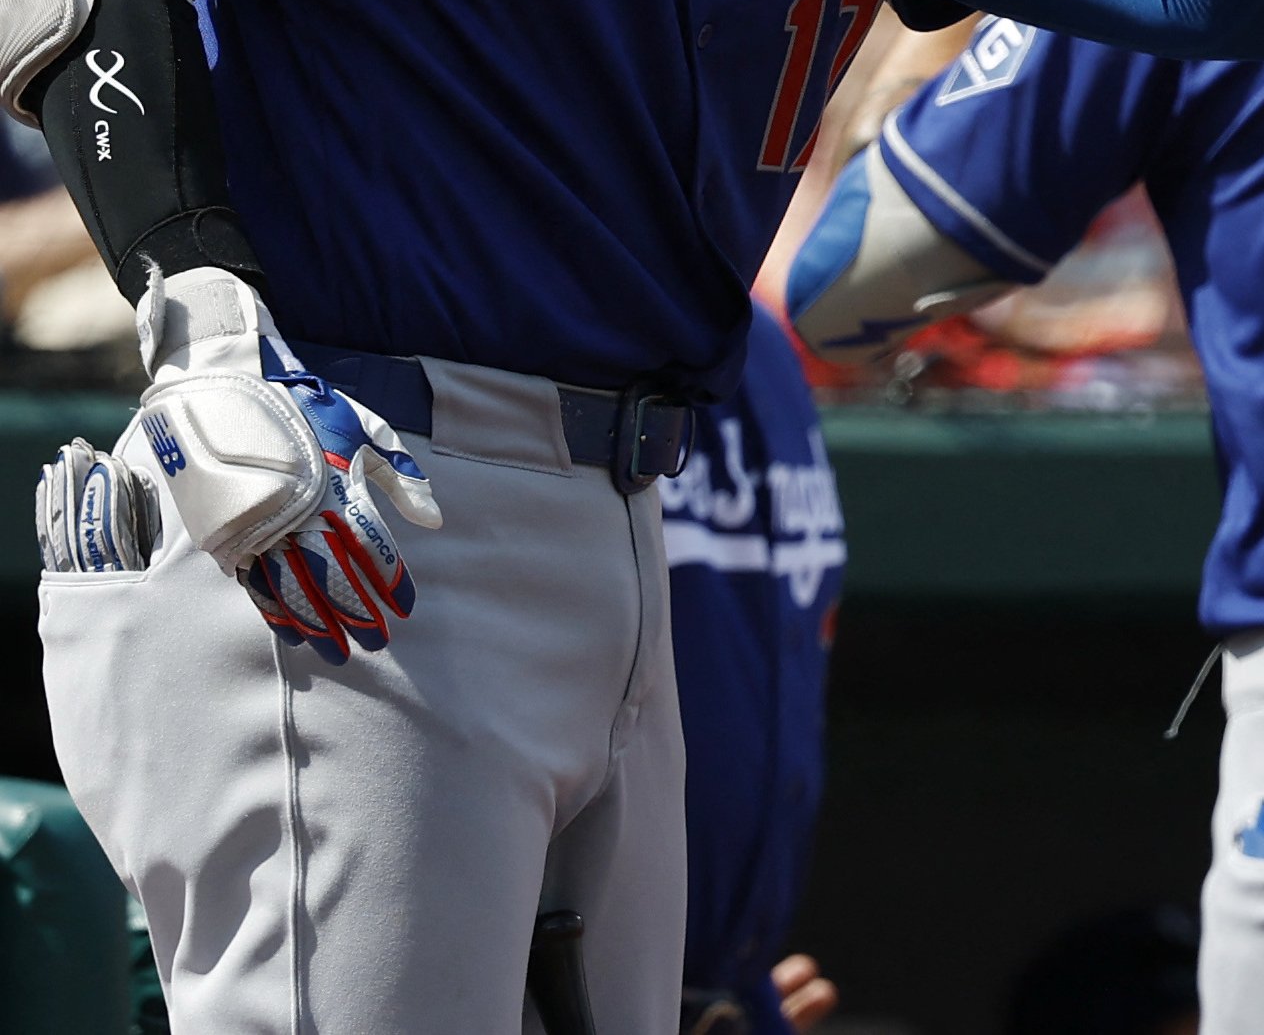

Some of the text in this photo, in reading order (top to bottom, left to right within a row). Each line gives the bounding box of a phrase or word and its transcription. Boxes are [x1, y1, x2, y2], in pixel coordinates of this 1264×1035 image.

[94, 119, 112, 162] CW-X
[330, 474, 396, 565] new balance
